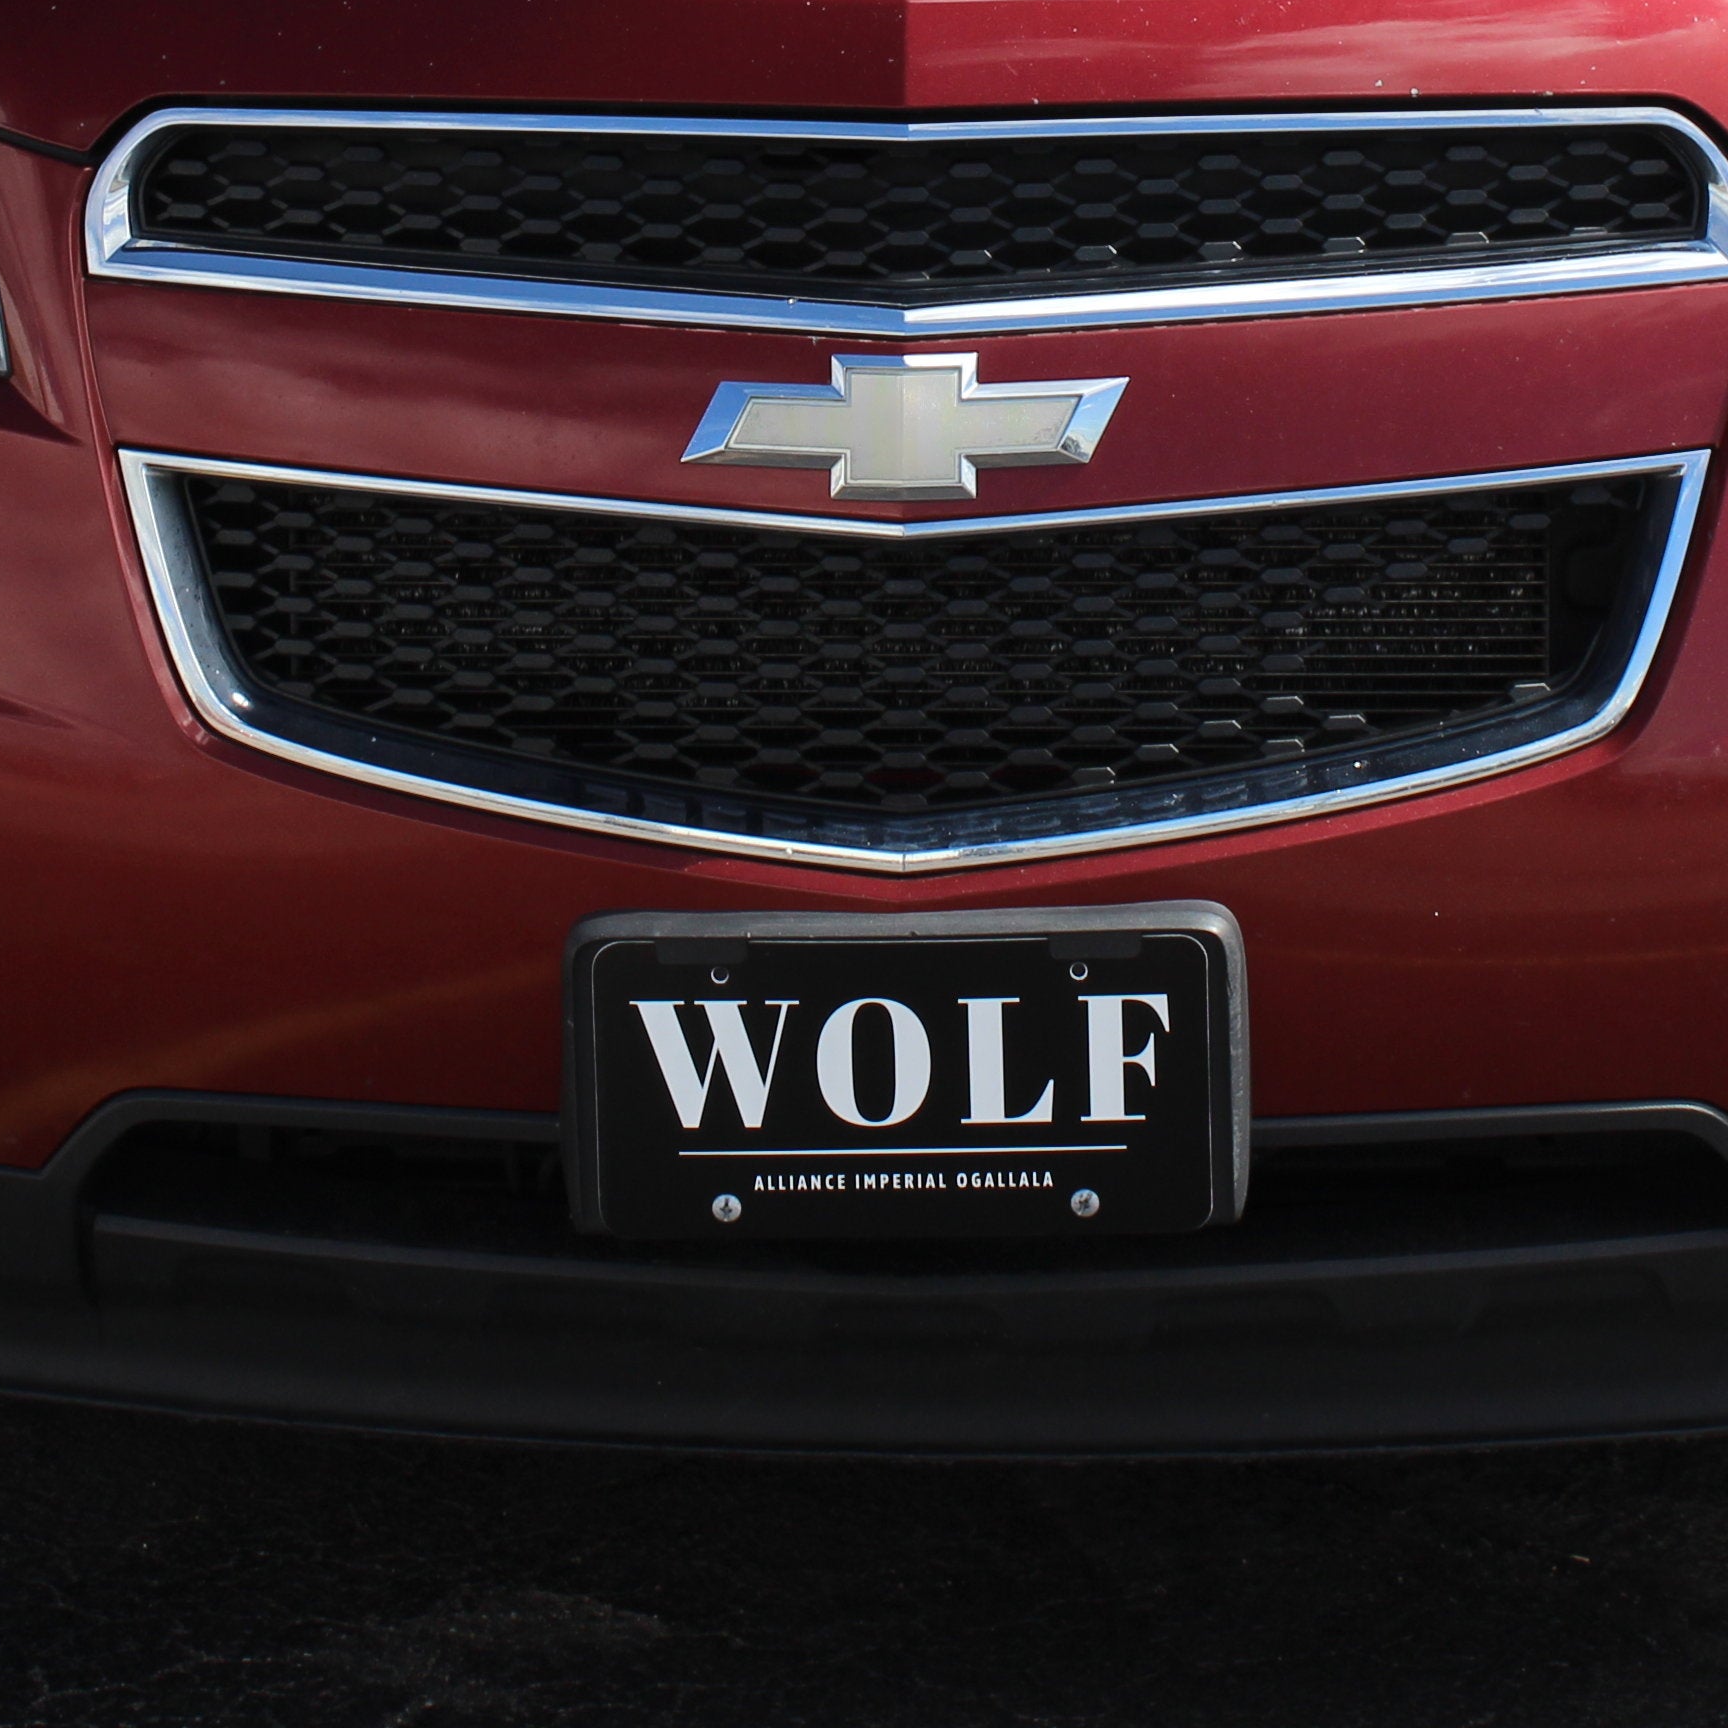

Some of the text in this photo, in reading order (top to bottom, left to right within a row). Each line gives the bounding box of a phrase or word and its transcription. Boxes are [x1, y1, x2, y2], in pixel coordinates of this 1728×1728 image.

[628, 993, 1170, 1129] WOLF
[754, 1171, 1054, 1191] ALLIANCE IMPERIAL OGALLALA
